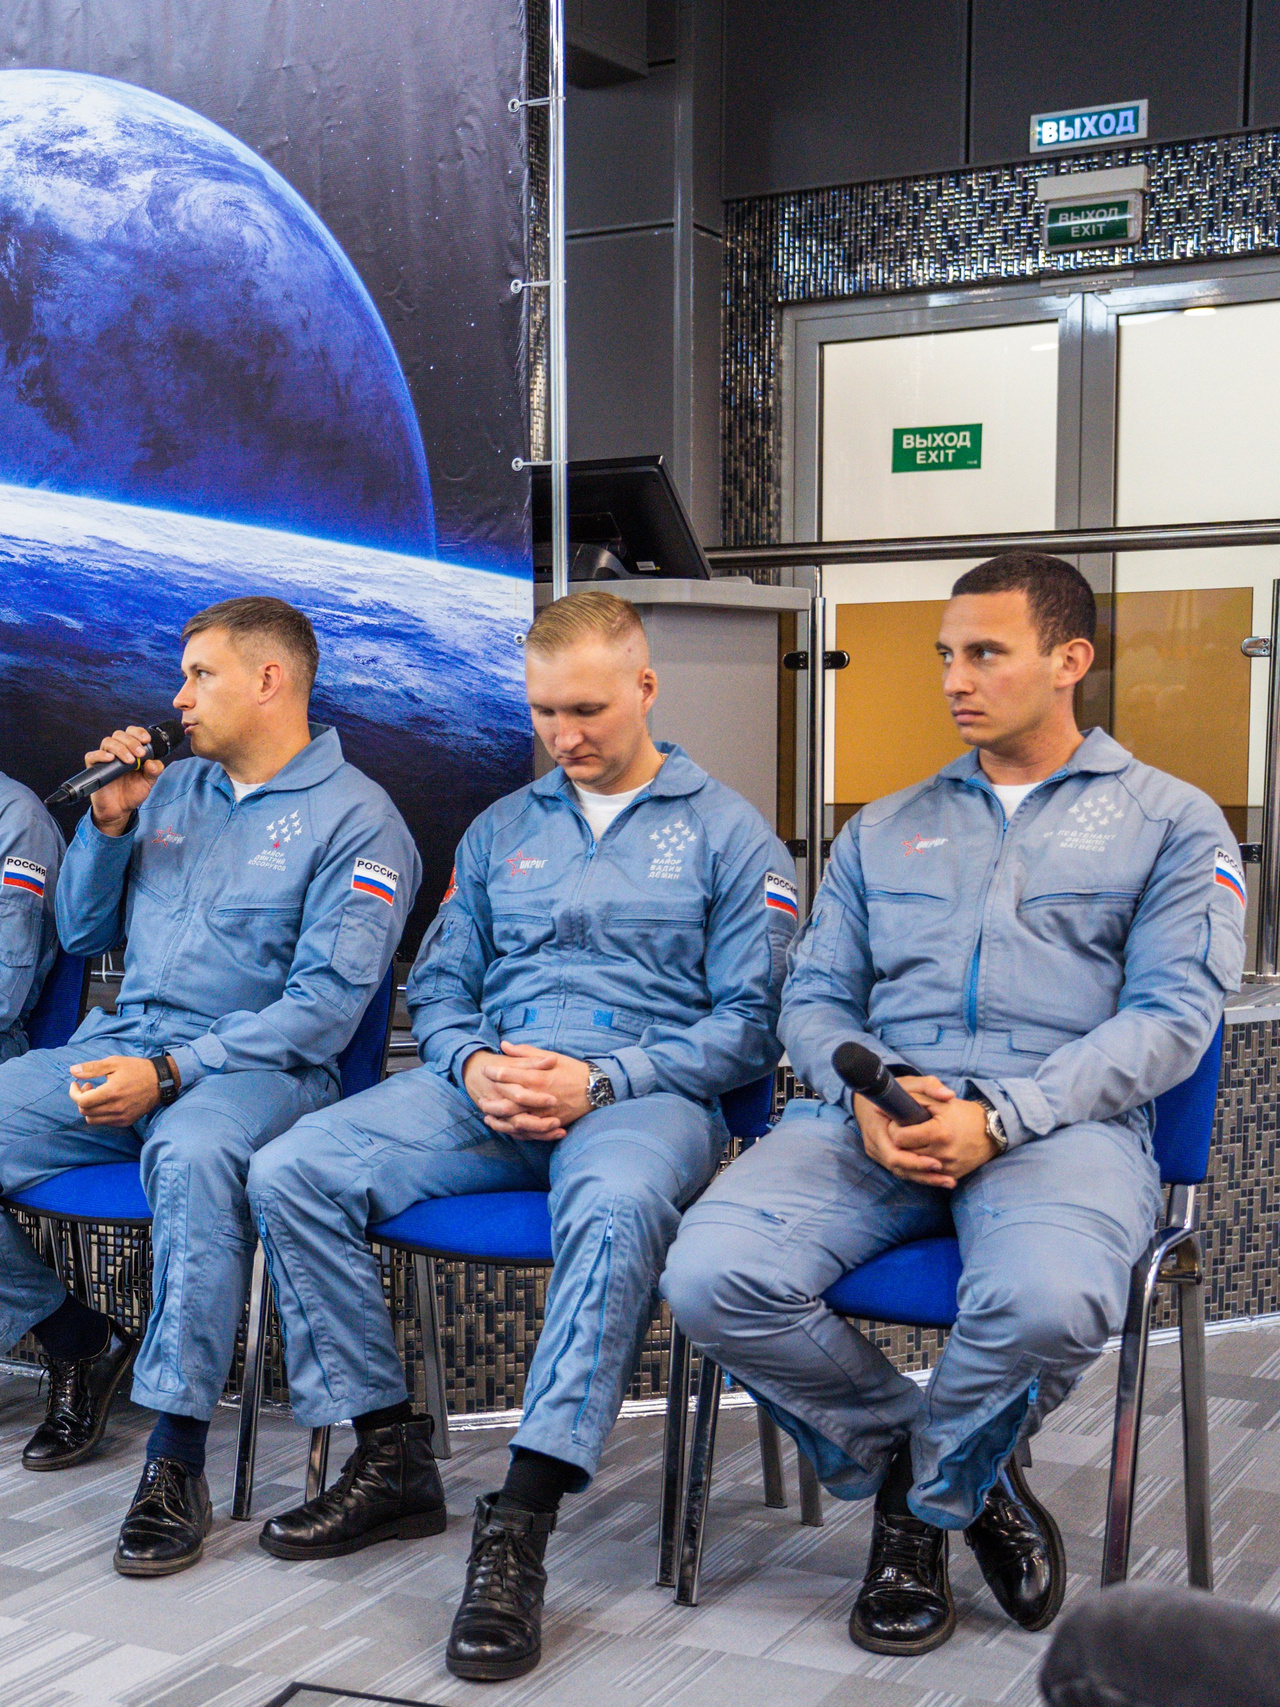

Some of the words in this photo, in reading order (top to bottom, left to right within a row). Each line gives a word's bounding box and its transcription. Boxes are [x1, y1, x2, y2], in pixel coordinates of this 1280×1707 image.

[1041, 110, 1135, 144] ВЫХОД
[1058, 207, 1119, 225] ВЫХОД
[1071, 223, 1106, 237] EXIT
[902, 431, 971, 449] ВЫХОД
[916, 449, 956, 464] EXIT
[6, 858, 46, 877] РОССИЯ
[357, 860, 398, 882] РОССИЯ
[647, 871, 680, 880] ДЕМИН
